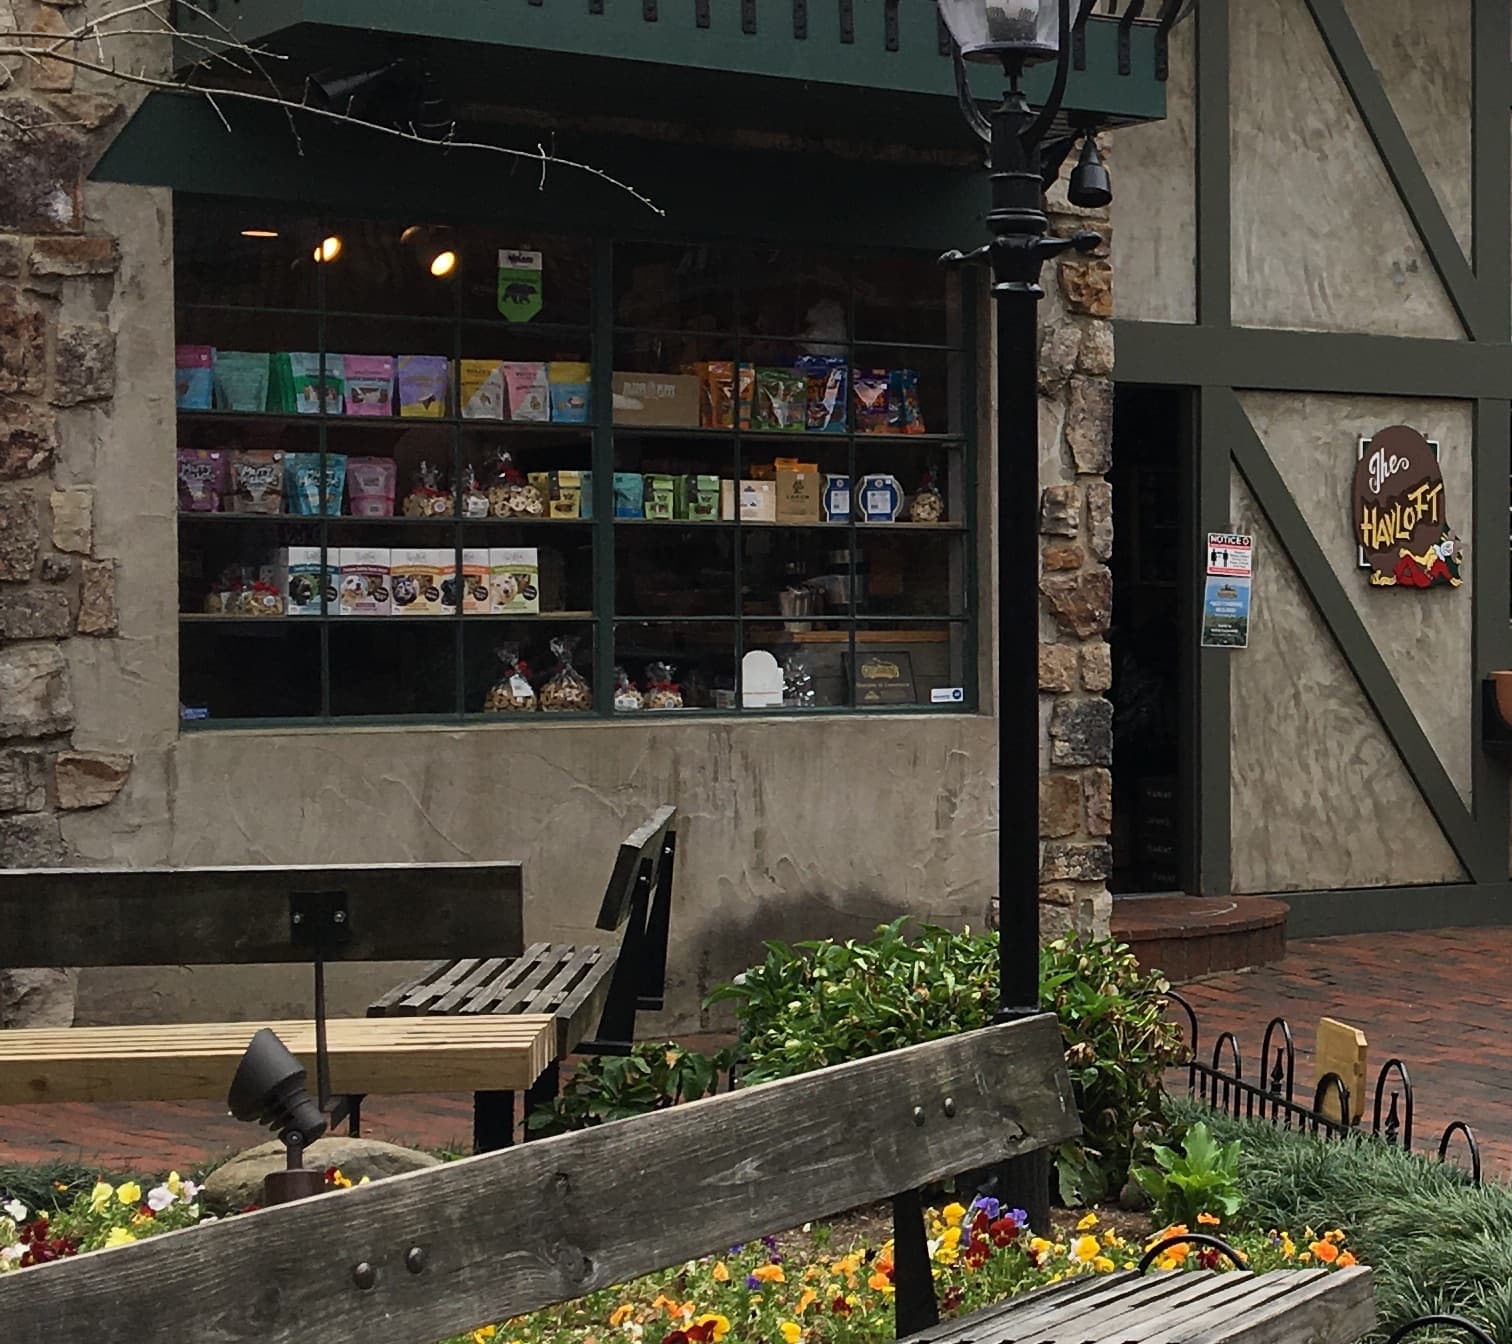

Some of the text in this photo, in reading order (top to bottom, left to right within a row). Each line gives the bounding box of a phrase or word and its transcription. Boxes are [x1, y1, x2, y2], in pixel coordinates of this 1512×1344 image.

[1368, 447, 1410, 494] The
[1360, 482, 1443, 550] HAYLOFT
[1210, 535, 1242, 545] NOTICE
